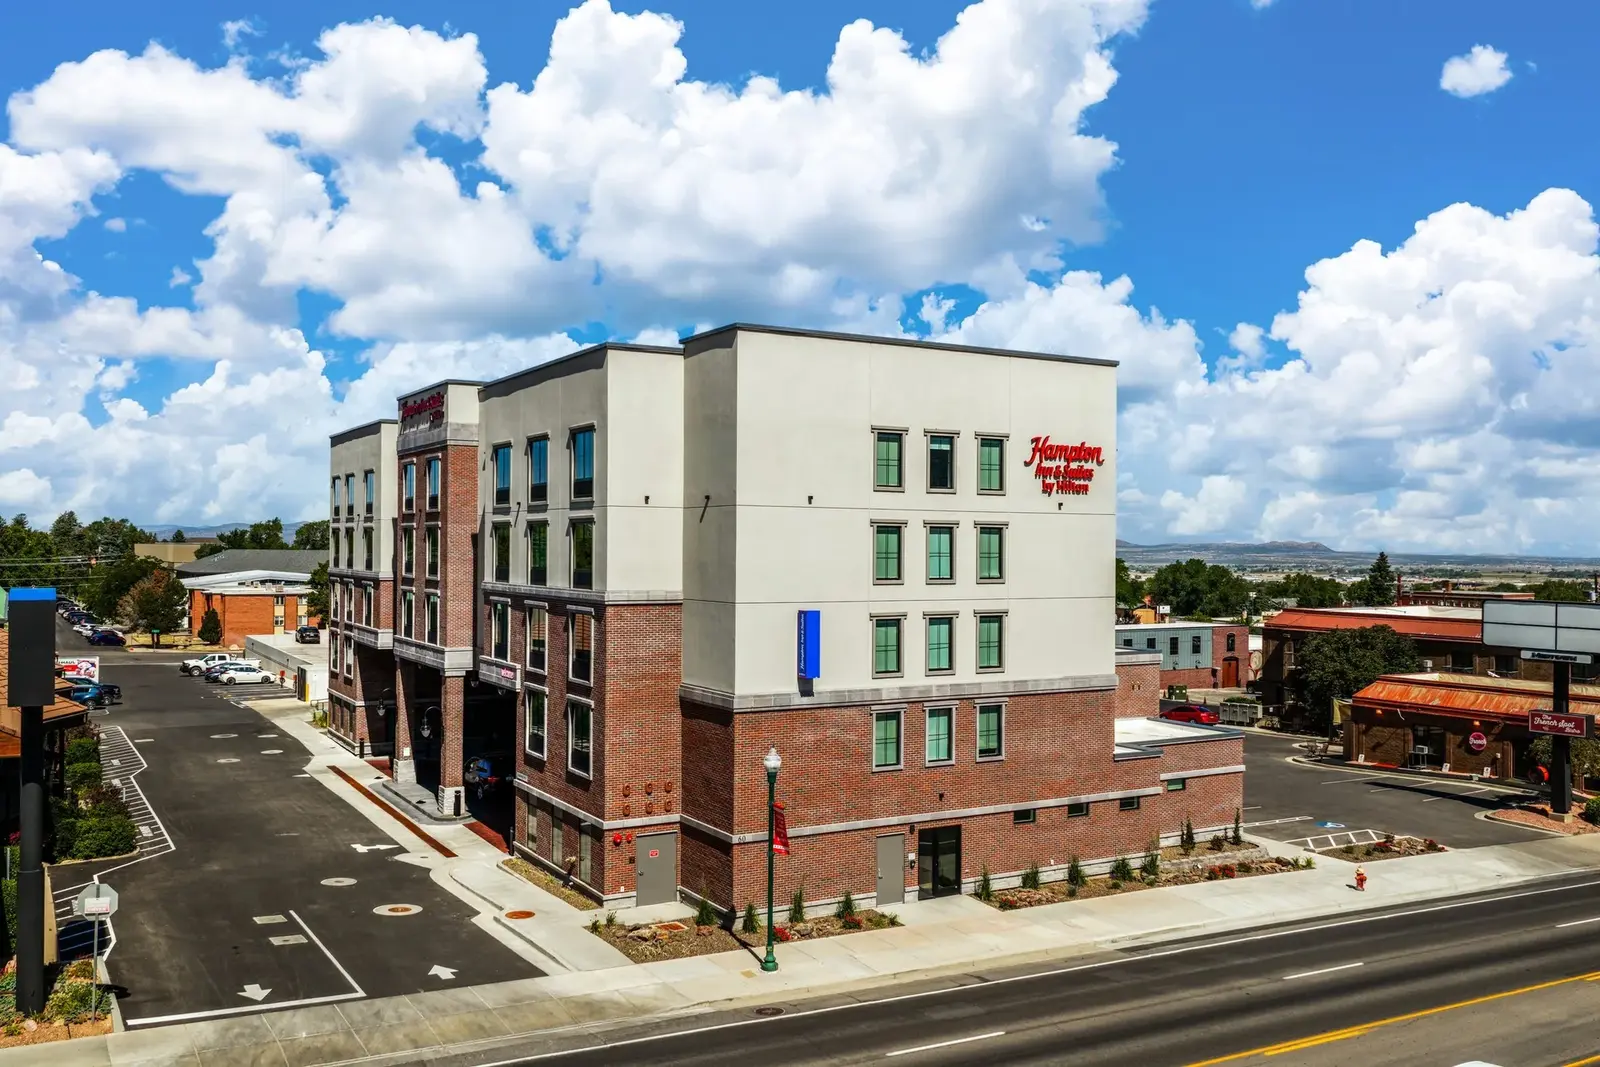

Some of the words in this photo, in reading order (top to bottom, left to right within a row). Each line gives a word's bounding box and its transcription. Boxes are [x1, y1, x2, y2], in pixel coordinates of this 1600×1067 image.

[1024, 435, 1105, 467] Hampton
[1035, 463, 1054, 479] Inn
[1054, 464, 1063, 480] &
[1063, 465, 1094, 481] Suites
[1042, 480, 1055, 497] by
[1056, 480, 1089, 495] Hilton
[1533, 717, 1558, 728] French
[1558, 719, 1575, 729] Spot
